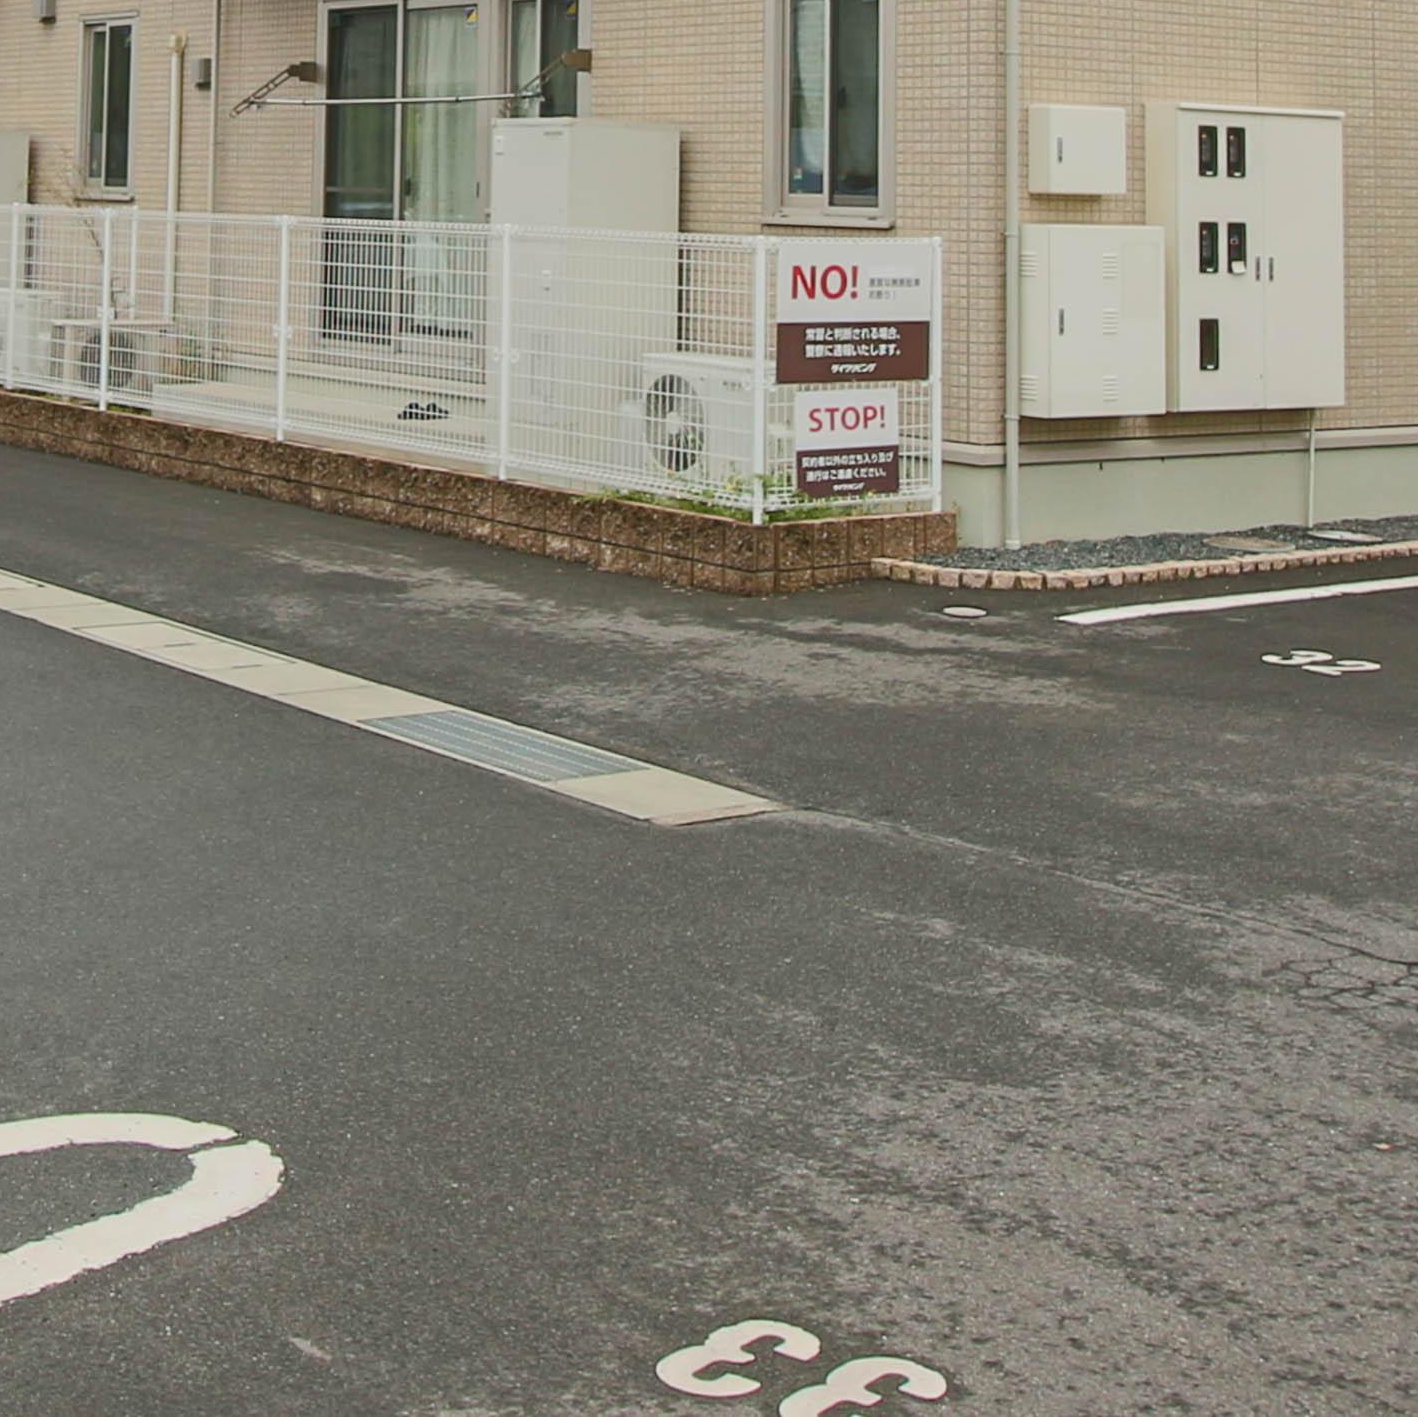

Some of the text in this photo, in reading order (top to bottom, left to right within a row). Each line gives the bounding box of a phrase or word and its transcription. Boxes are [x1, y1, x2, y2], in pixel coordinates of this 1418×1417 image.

[791, 265, 859, 300] NO!
[808, 405, 886, 433] STOP!
[1261, 649, 1382, 677] 32
[655, 1318, 948, 1417] 33
